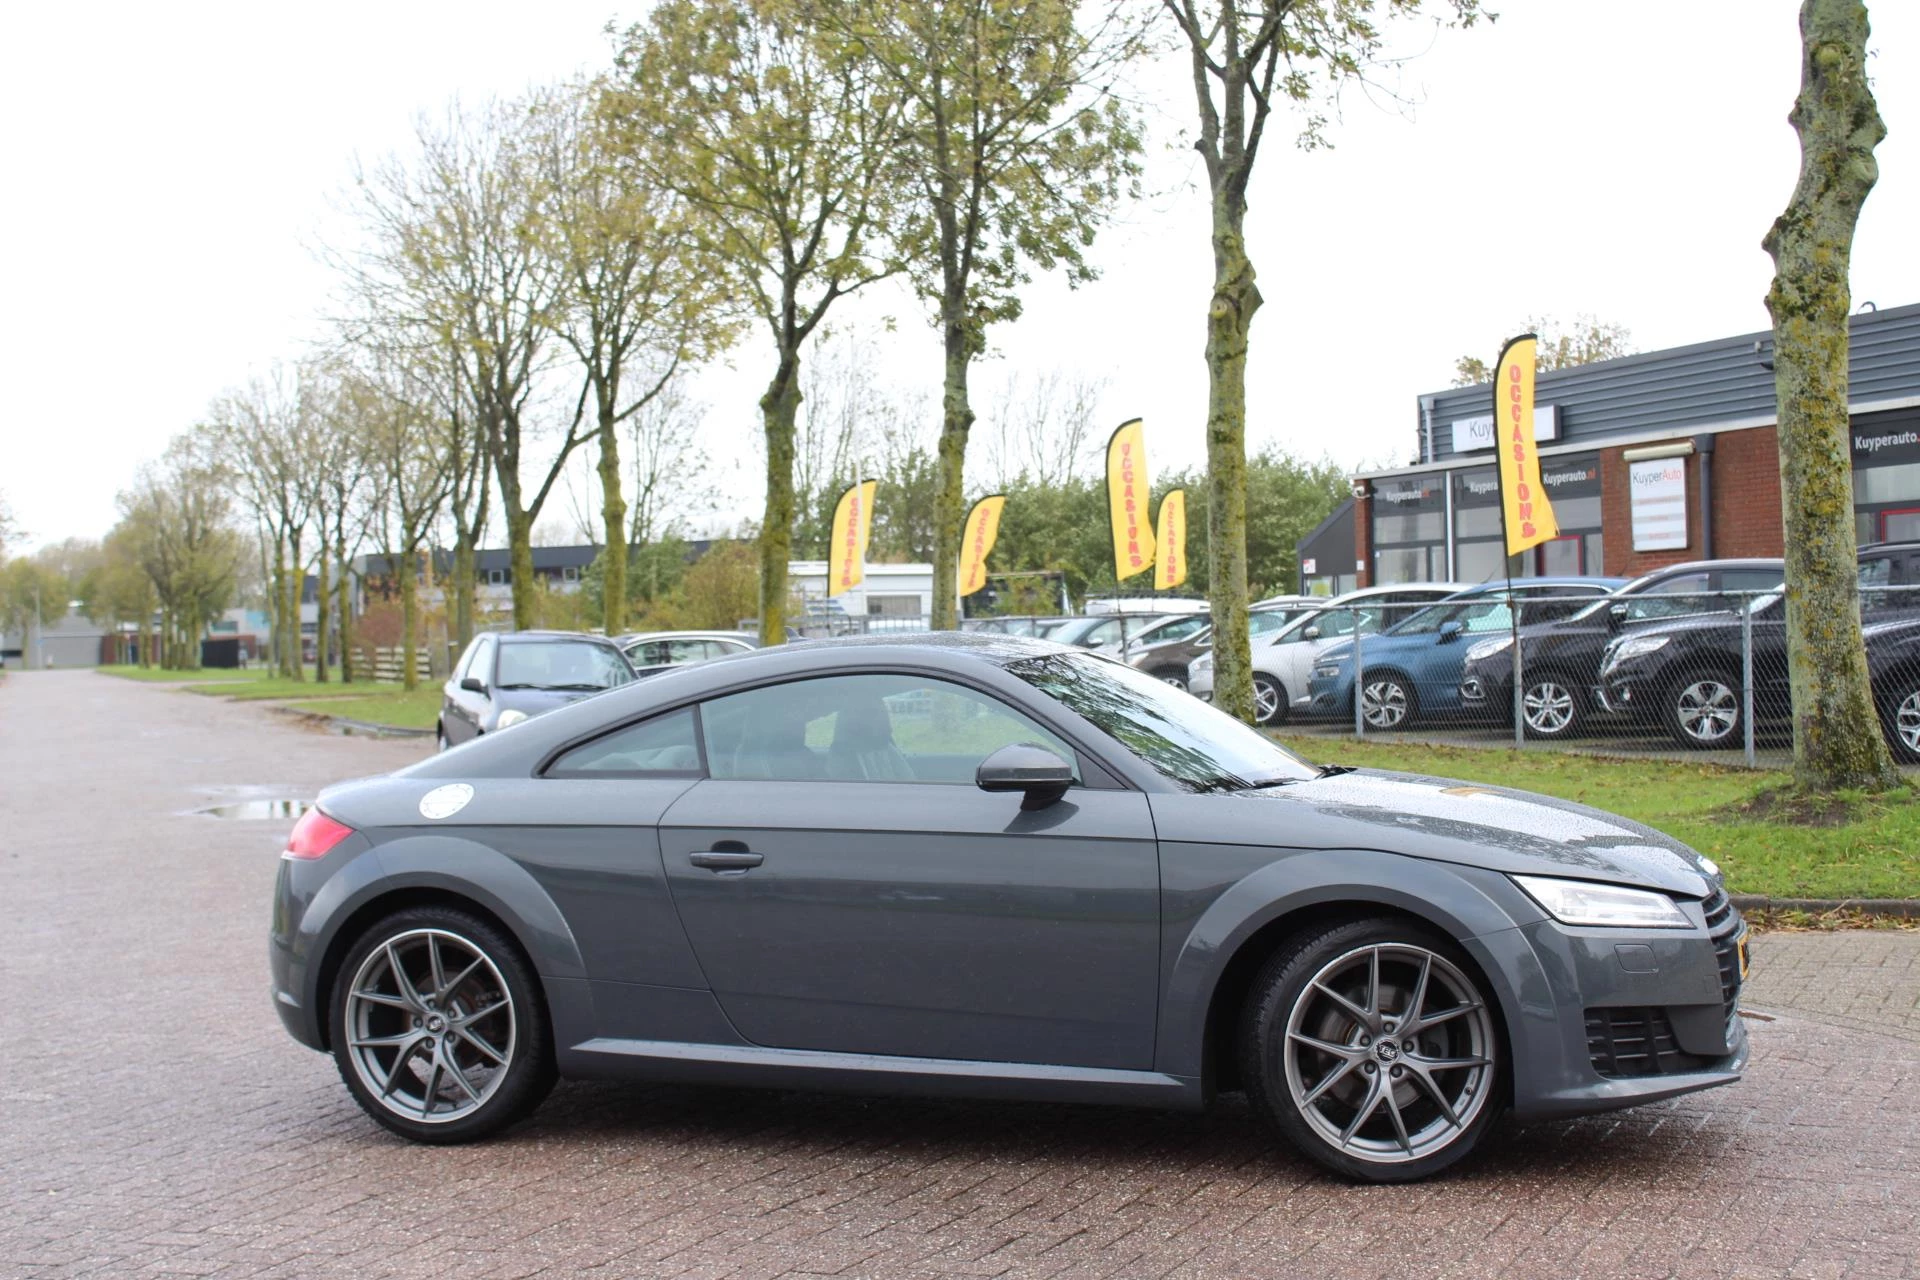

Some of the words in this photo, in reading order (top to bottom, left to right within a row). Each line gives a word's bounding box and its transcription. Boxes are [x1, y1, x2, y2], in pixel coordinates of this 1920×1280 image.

[1509, 365, 1536, 538] OCCASIONS
[1543, 468, 1597, 486] Kuyperauto.nl
[1121, 443, 1143, 567] OCCASIONS
[1167, 502, 1177, 583] OCCASIONS
